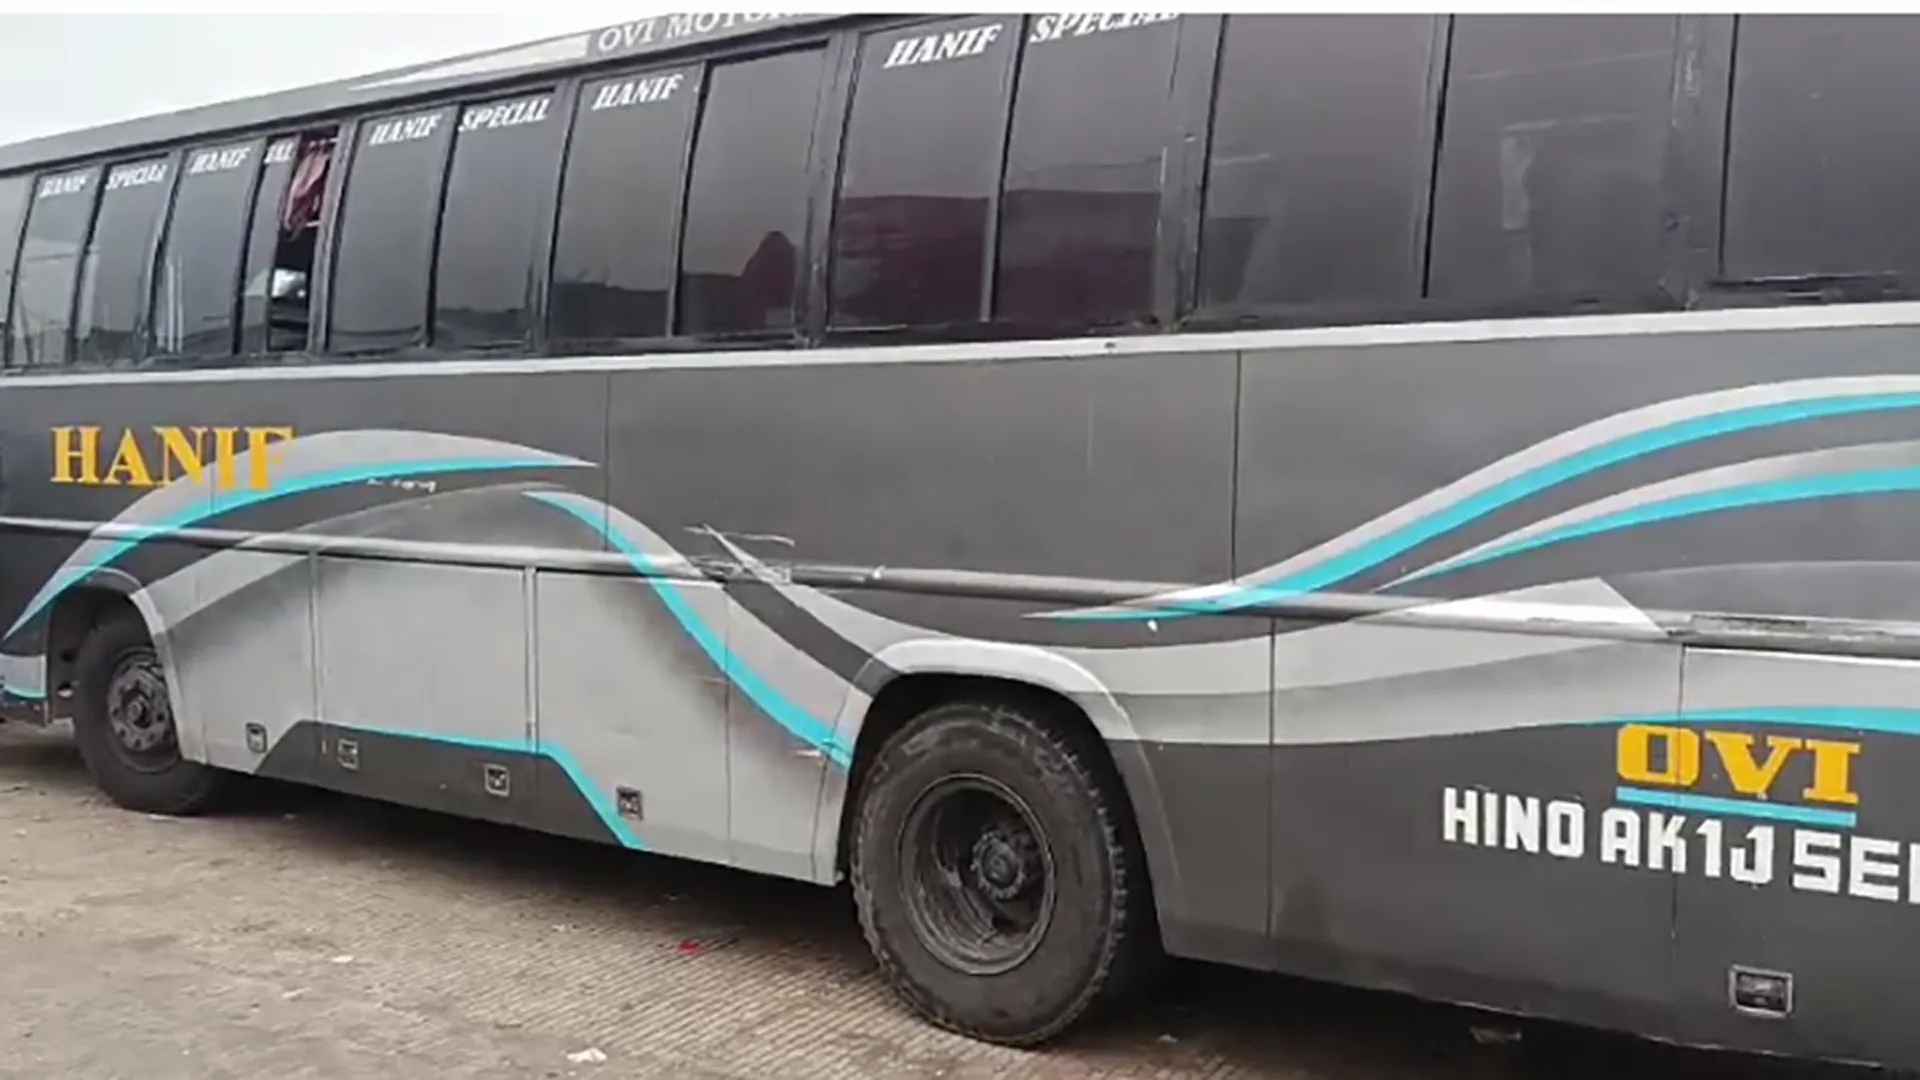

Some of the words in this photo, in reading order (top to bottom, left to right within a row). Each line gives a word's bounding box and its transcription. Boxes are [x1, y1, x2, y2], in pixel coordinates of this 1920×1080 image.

[598, 22, 656, 51] OVI
[882, 24, 1003, 69] HANIF
[592, 74, 683, 110] HANIF
[369, 114, 442, 146] HANIF
[458, 98, 550, 132] SPECIAL
[49, 425, 295, 491] HANIF
[1616, 723, 1861, 804] OVI
[1443, 787, 1585, 859] HINO
[1600, 807, 1774, 885] AK1J
[1792, 828, 1920, 905] SE
